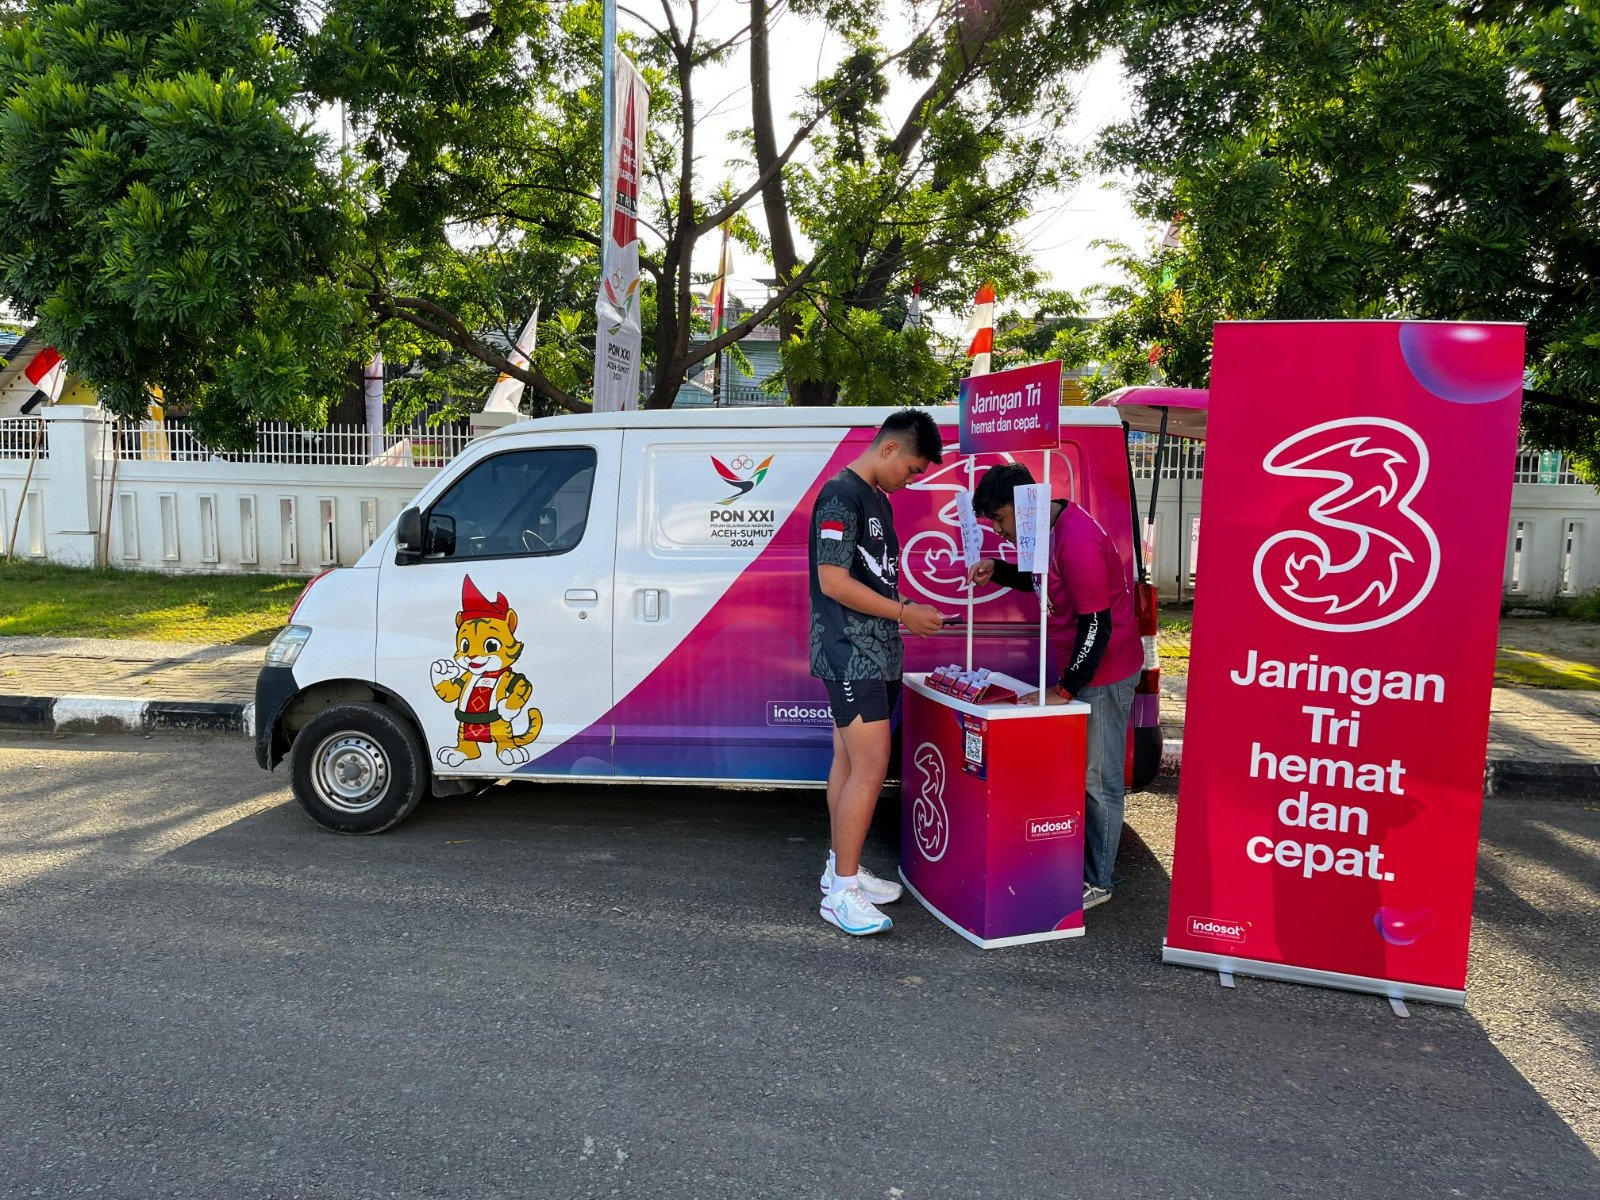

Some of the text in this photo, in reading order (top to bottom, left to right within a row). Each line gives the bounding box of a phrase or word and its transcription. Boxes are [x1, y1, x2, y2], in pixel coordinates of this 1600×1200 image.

[608, 343, 620, 357] PON
[971, 382, 1042, 415] Jaringan Tri
[971, 413, 1041, 434] hemat dan cepat.
[710, 509, 774, 522] PON XXI
[710, 529, 774, 538] ACEH-SUMUT
[730, 539, 754, 547] 2024
[1230, 650, 1446, 706] Jaringan
[774, 705, 834, 718] indosat
[1302, 705, 1361, 748] Tri
[1249, 742, 1406, 795] hemat
[1277, 792, 1369, 835] dan
[1031, 819, 1072, 834] indosat
[1246, 835, 1396, 882] cepat.
[1193, 919, 1240, 936] indosat
